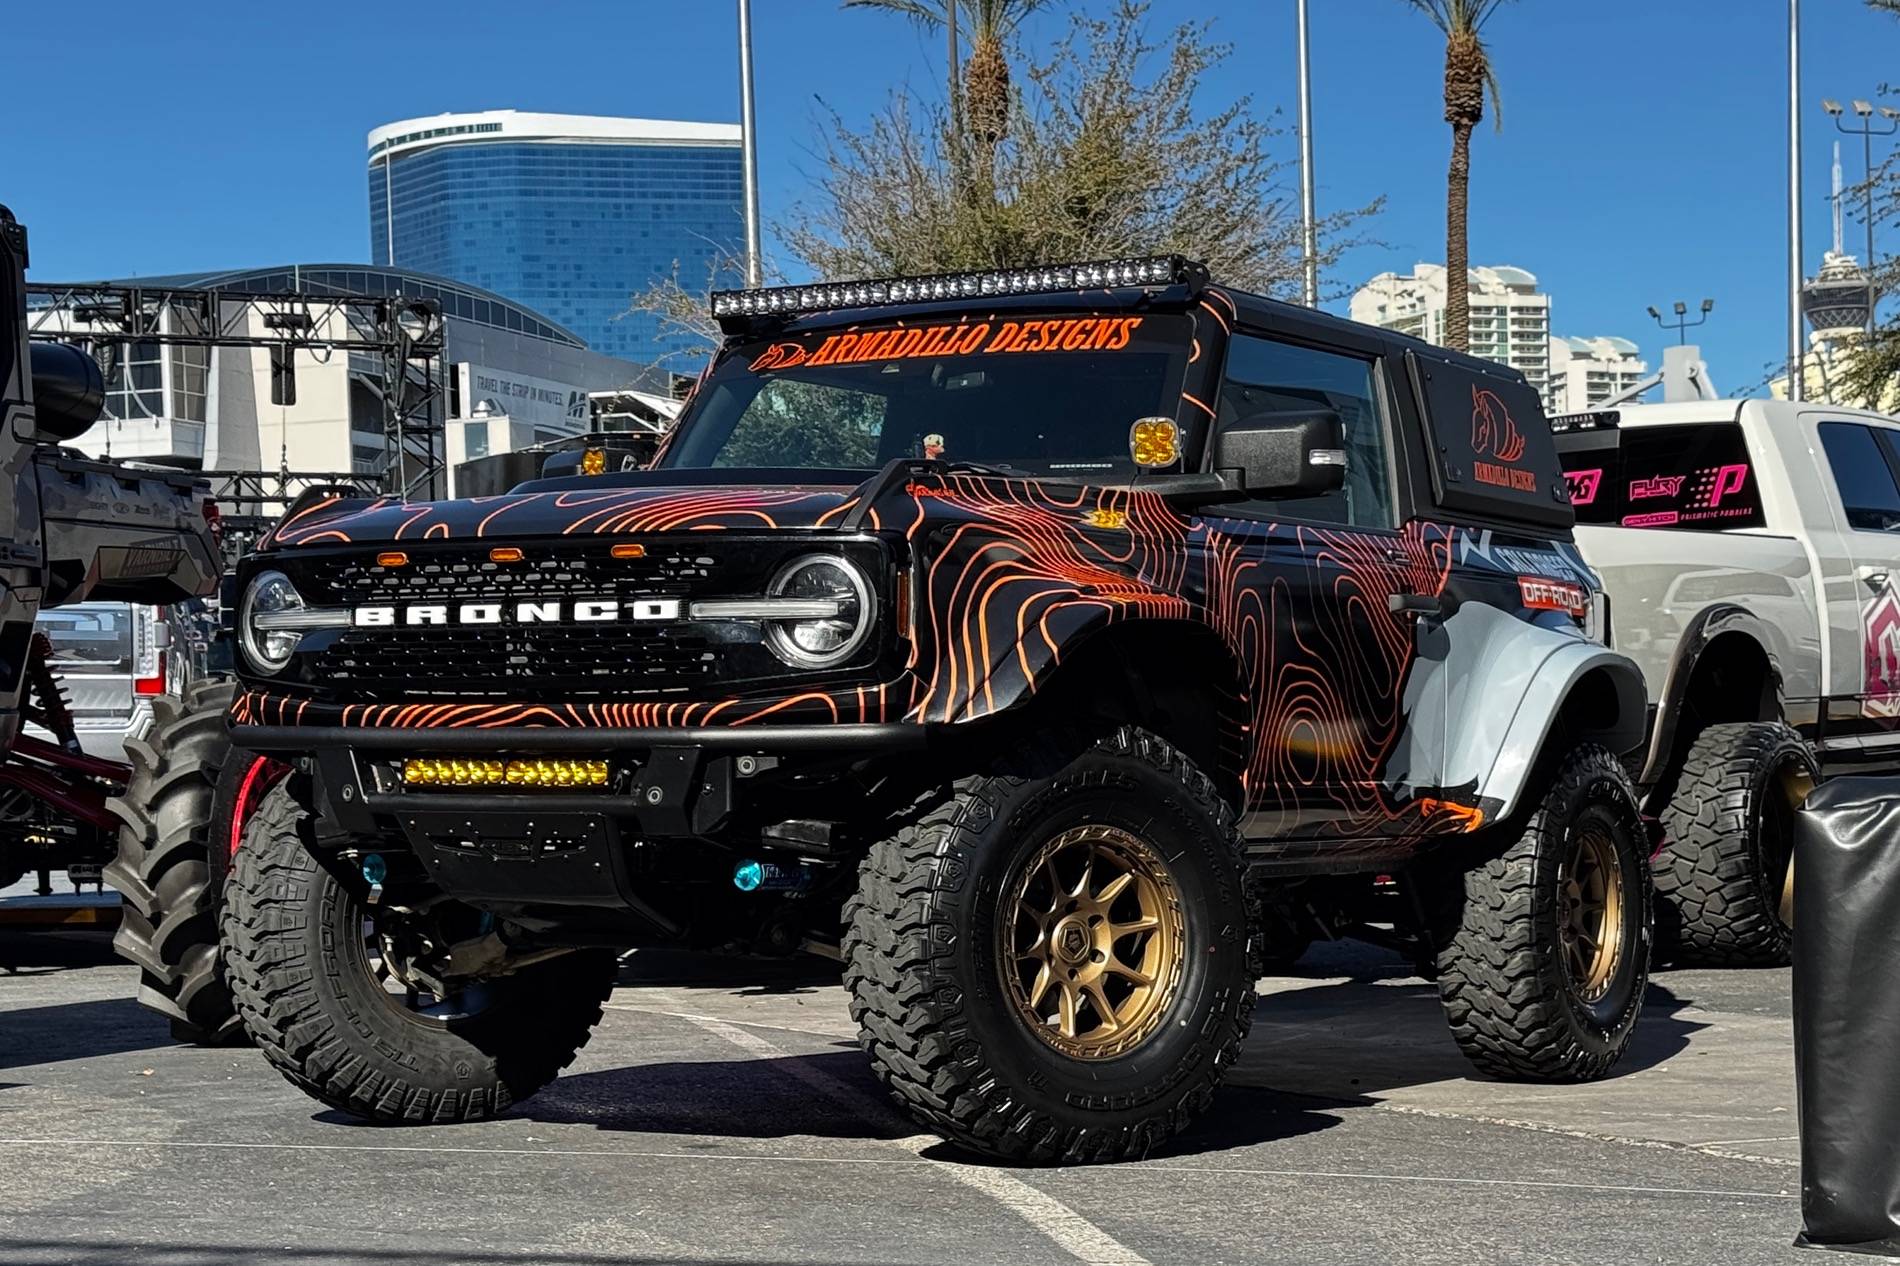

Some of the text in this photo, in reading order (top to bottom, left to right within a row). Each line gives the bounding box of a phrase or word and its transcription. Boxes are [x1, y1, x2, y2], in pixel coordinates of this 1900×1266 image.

[806, 317, 1142, 367] ARMADILLO DESIGNS
[477, 375, 498, 393] TRAVEL
[500, 380, 511, 396] THE
[512, 383, 529, 399] STRIP
[529, 387, 537, 401] IN
[1474, 461, 1510, 487] ARMADILLO
[1630, 475, 1686, 501] FURY
[1680, 511, 1719, 521] PRISMATIC
[1522, 582, 1582, 609] OFF-ROAD
[355, 600, 679, 626] BRONCO
